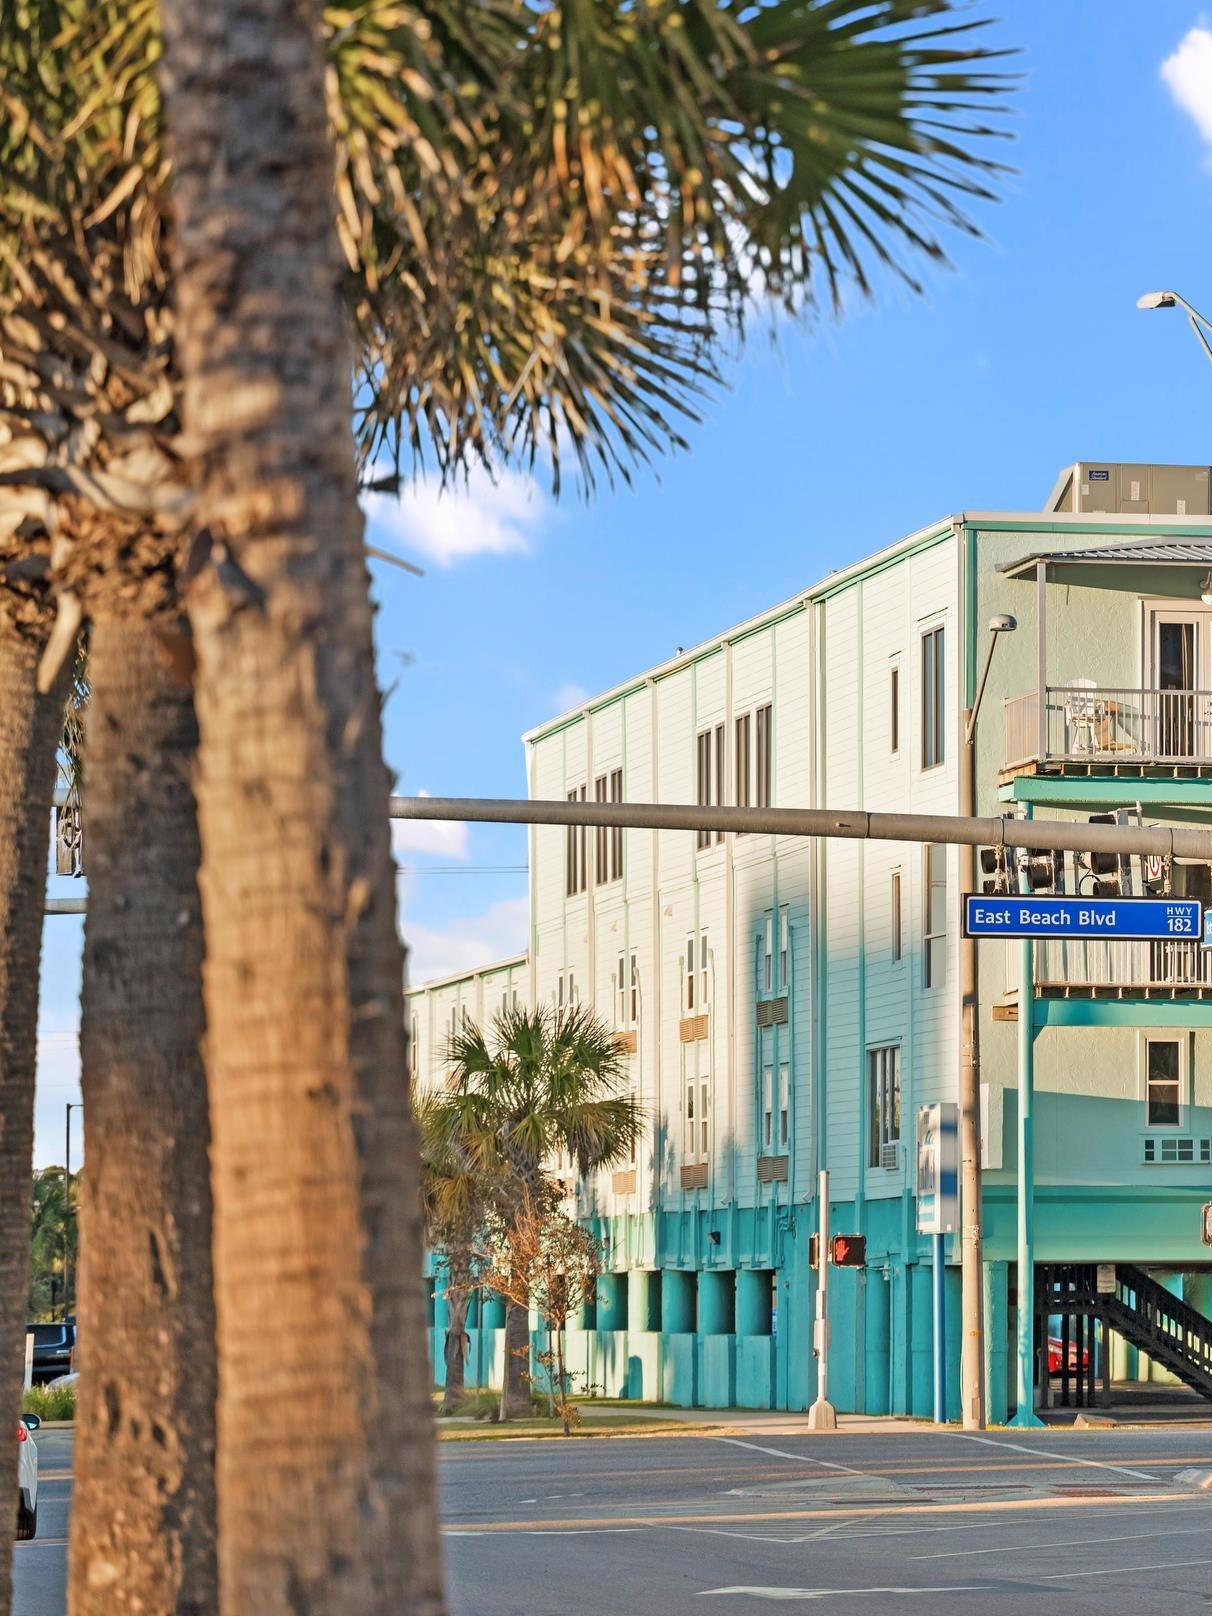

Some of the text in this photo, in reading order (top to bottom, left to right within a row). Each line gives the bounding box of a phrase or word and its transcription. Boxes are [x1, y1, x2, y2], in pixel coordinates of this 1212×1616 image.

[975, 909, 1116, 926] East Beach Blvd
[1167, 906, 1192, 915] HWY
[1168, 918, 1192, 932] 182
